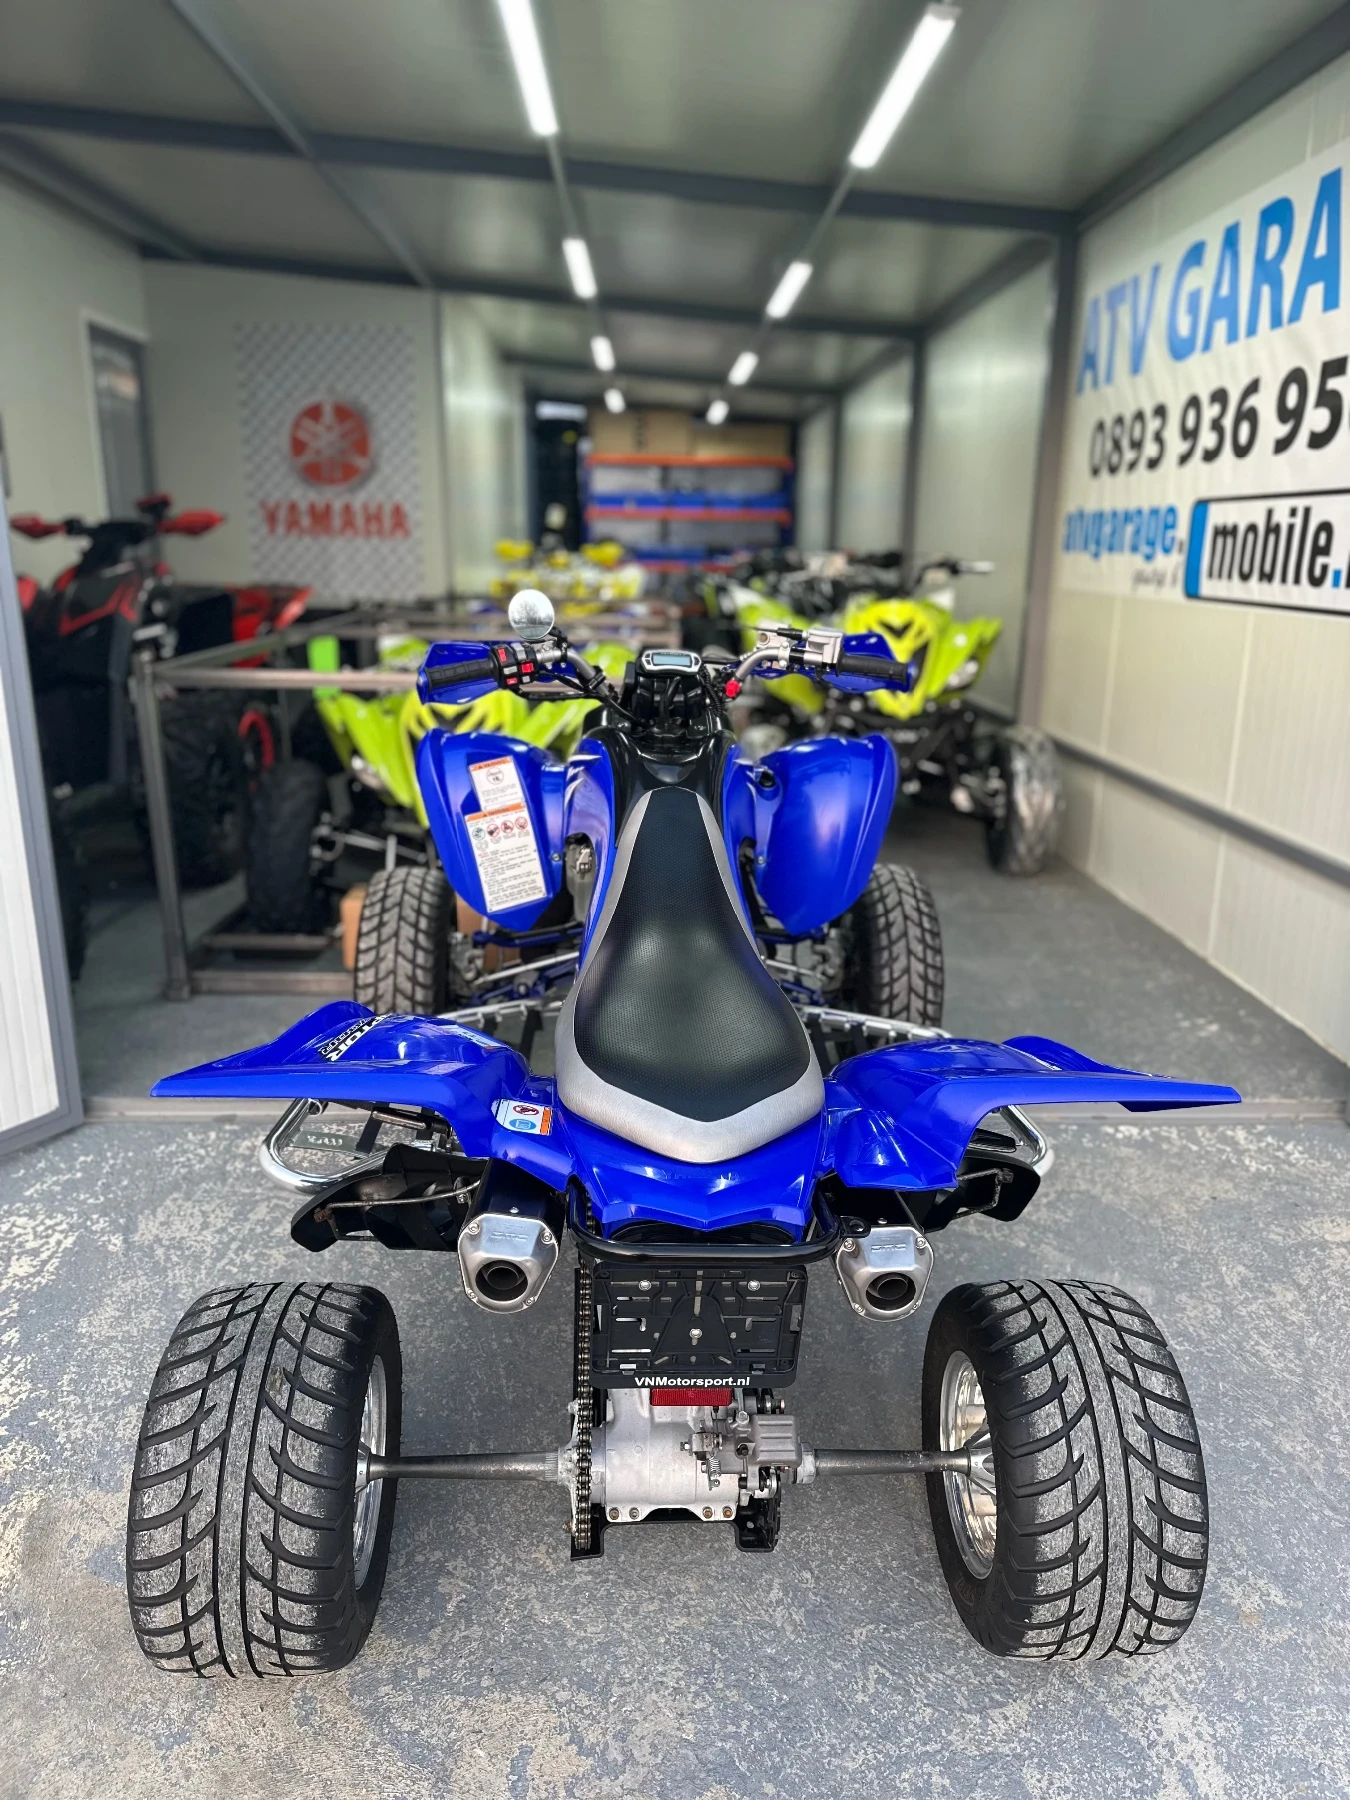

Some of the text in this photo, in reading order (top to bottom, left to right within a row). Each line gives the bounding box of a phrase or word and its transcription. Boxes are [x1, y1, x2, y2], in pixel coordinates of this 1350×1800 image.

[1076, 167, 1343, 395] ATV GARA
[1089, 355, 1350, 478] 0893 936 95
[259, 500, 411, 539] YAMAHA
[1206, 506, 1350, 590] mobile.
[634, 1376, 751, 1388] VNMotorsport.nl
